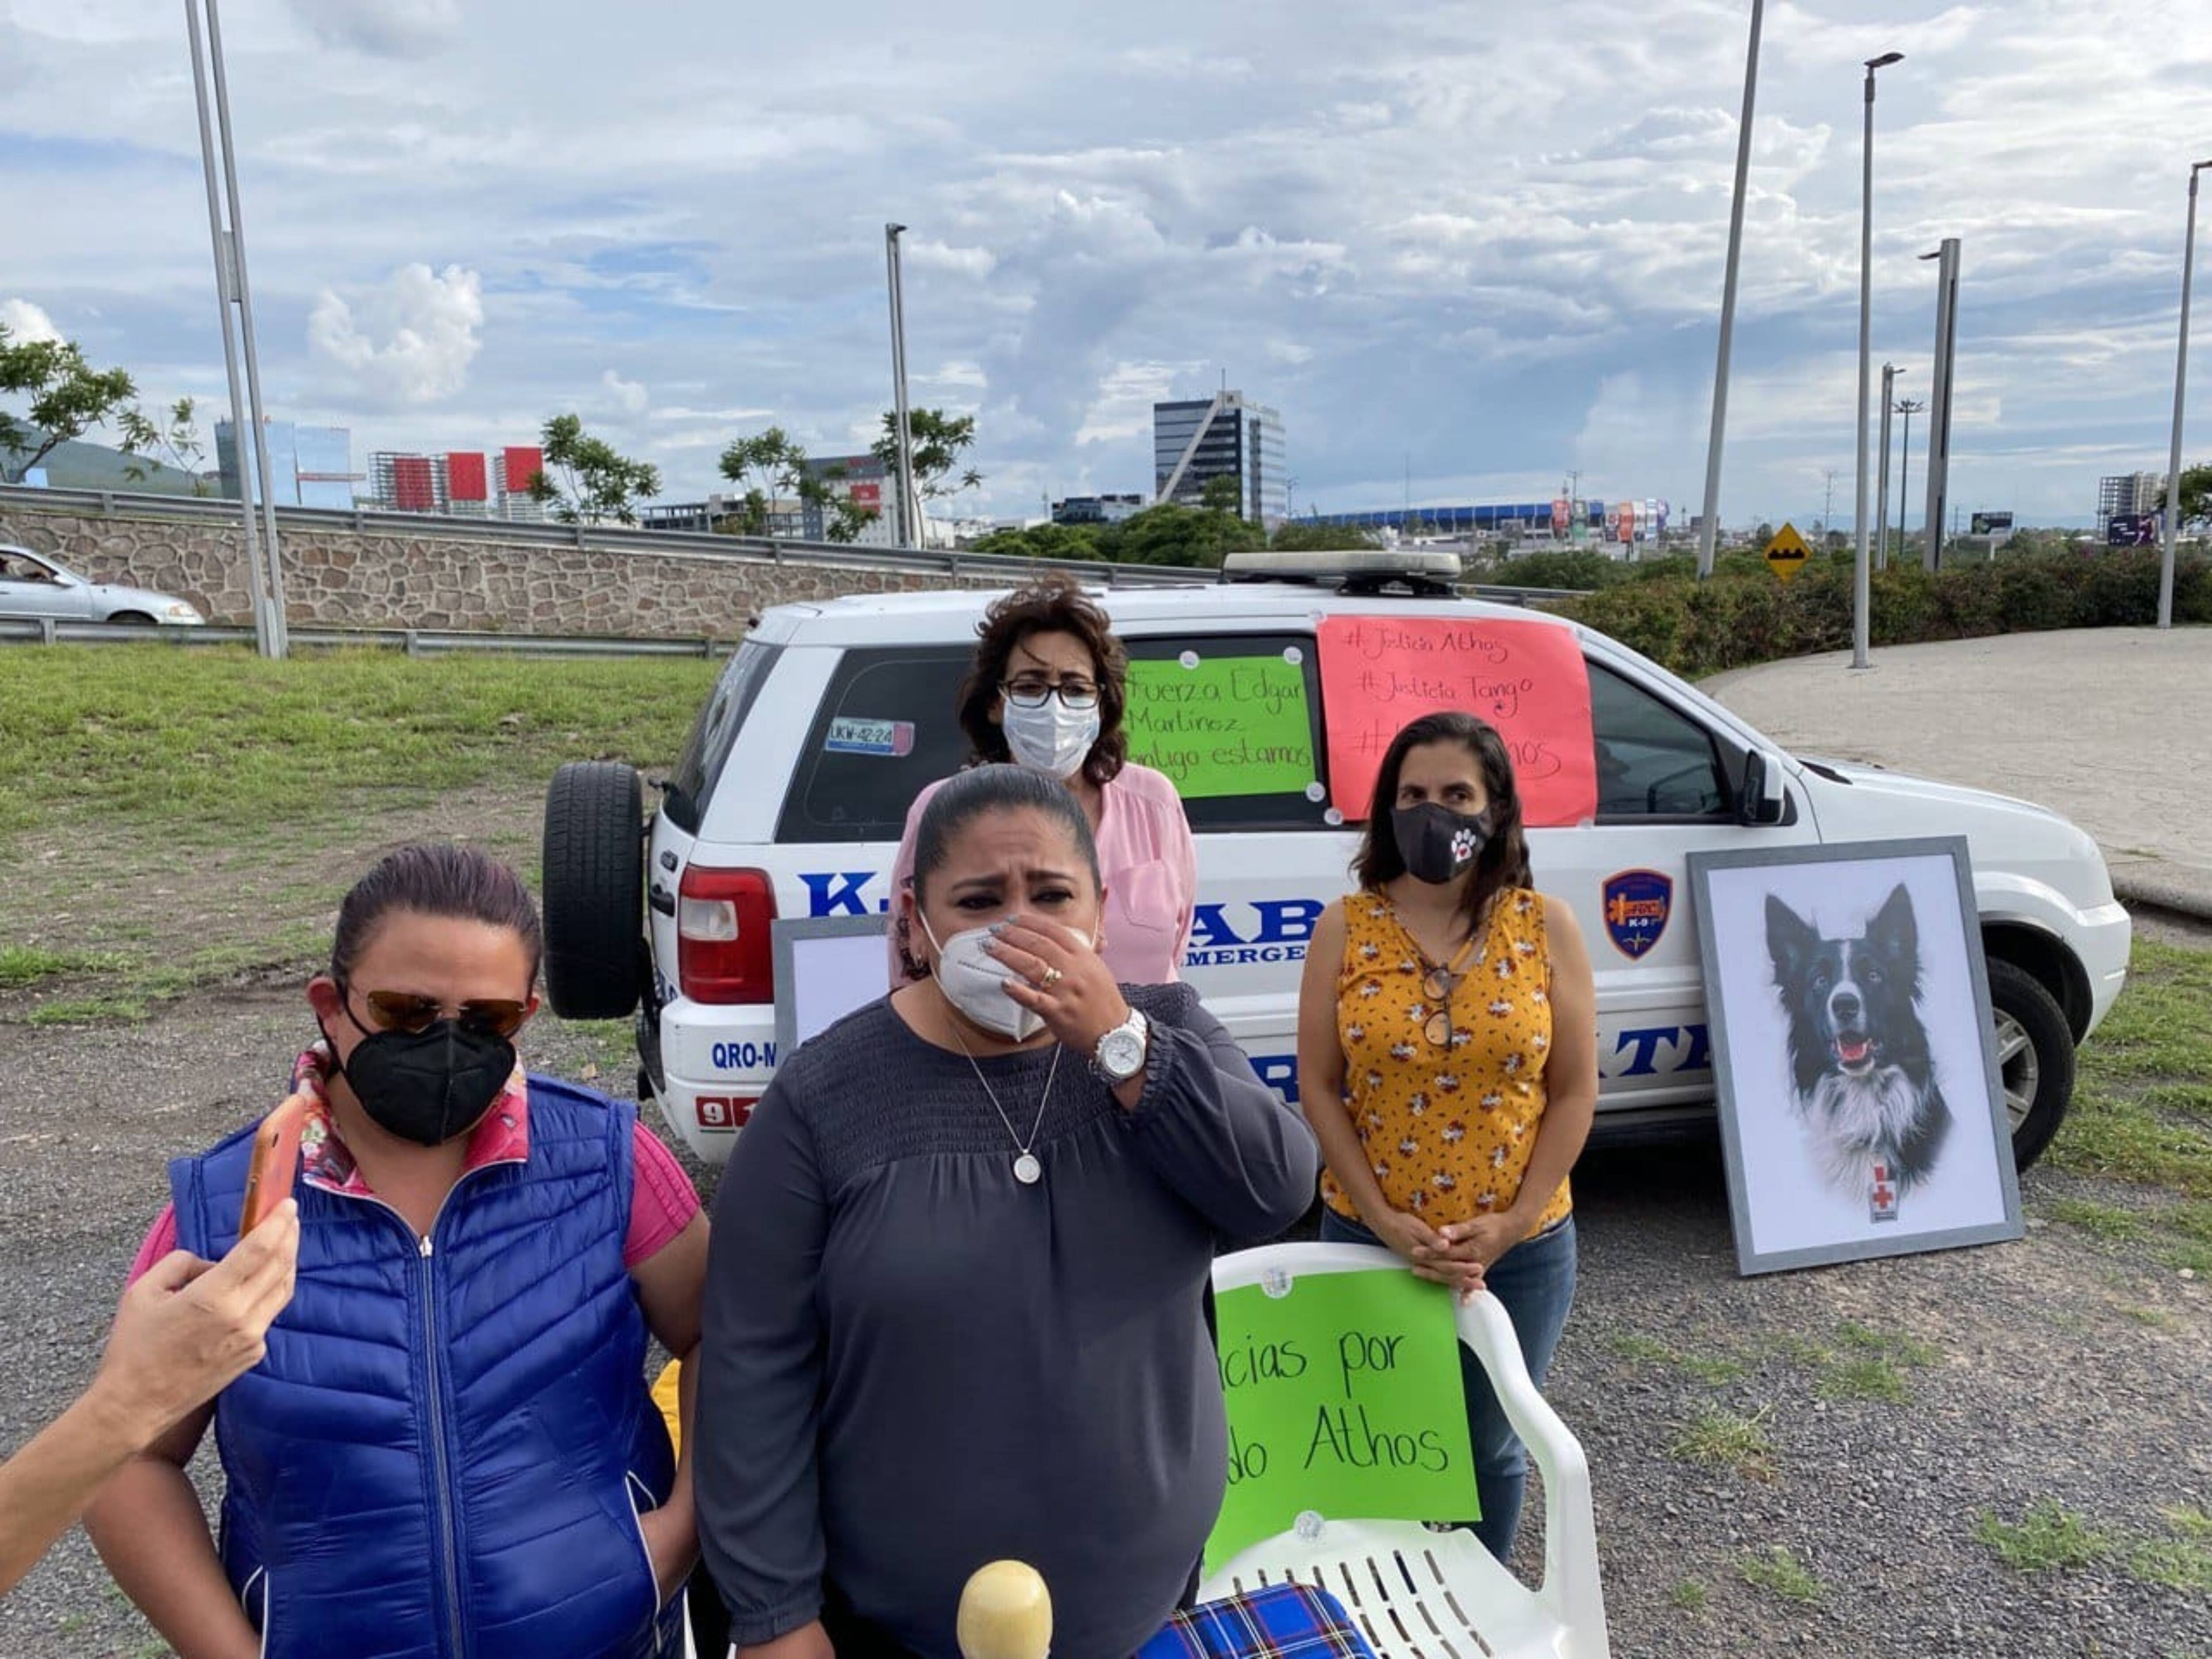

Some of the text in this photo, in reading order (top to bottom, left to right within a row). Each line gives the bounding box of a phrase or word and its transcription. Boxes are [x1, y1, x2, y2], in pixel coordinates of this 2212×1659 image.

[1231, 668, 1300, 715] Edgar
[1465, 675, 1534, 718] Tango
[1212, 738, 1310, 767] estamos
[1180, 945, 1306, 967] MERGE
[1339, 1332, 1405, 1398] por
[1304, 1404, 1449, 1472] Athos
